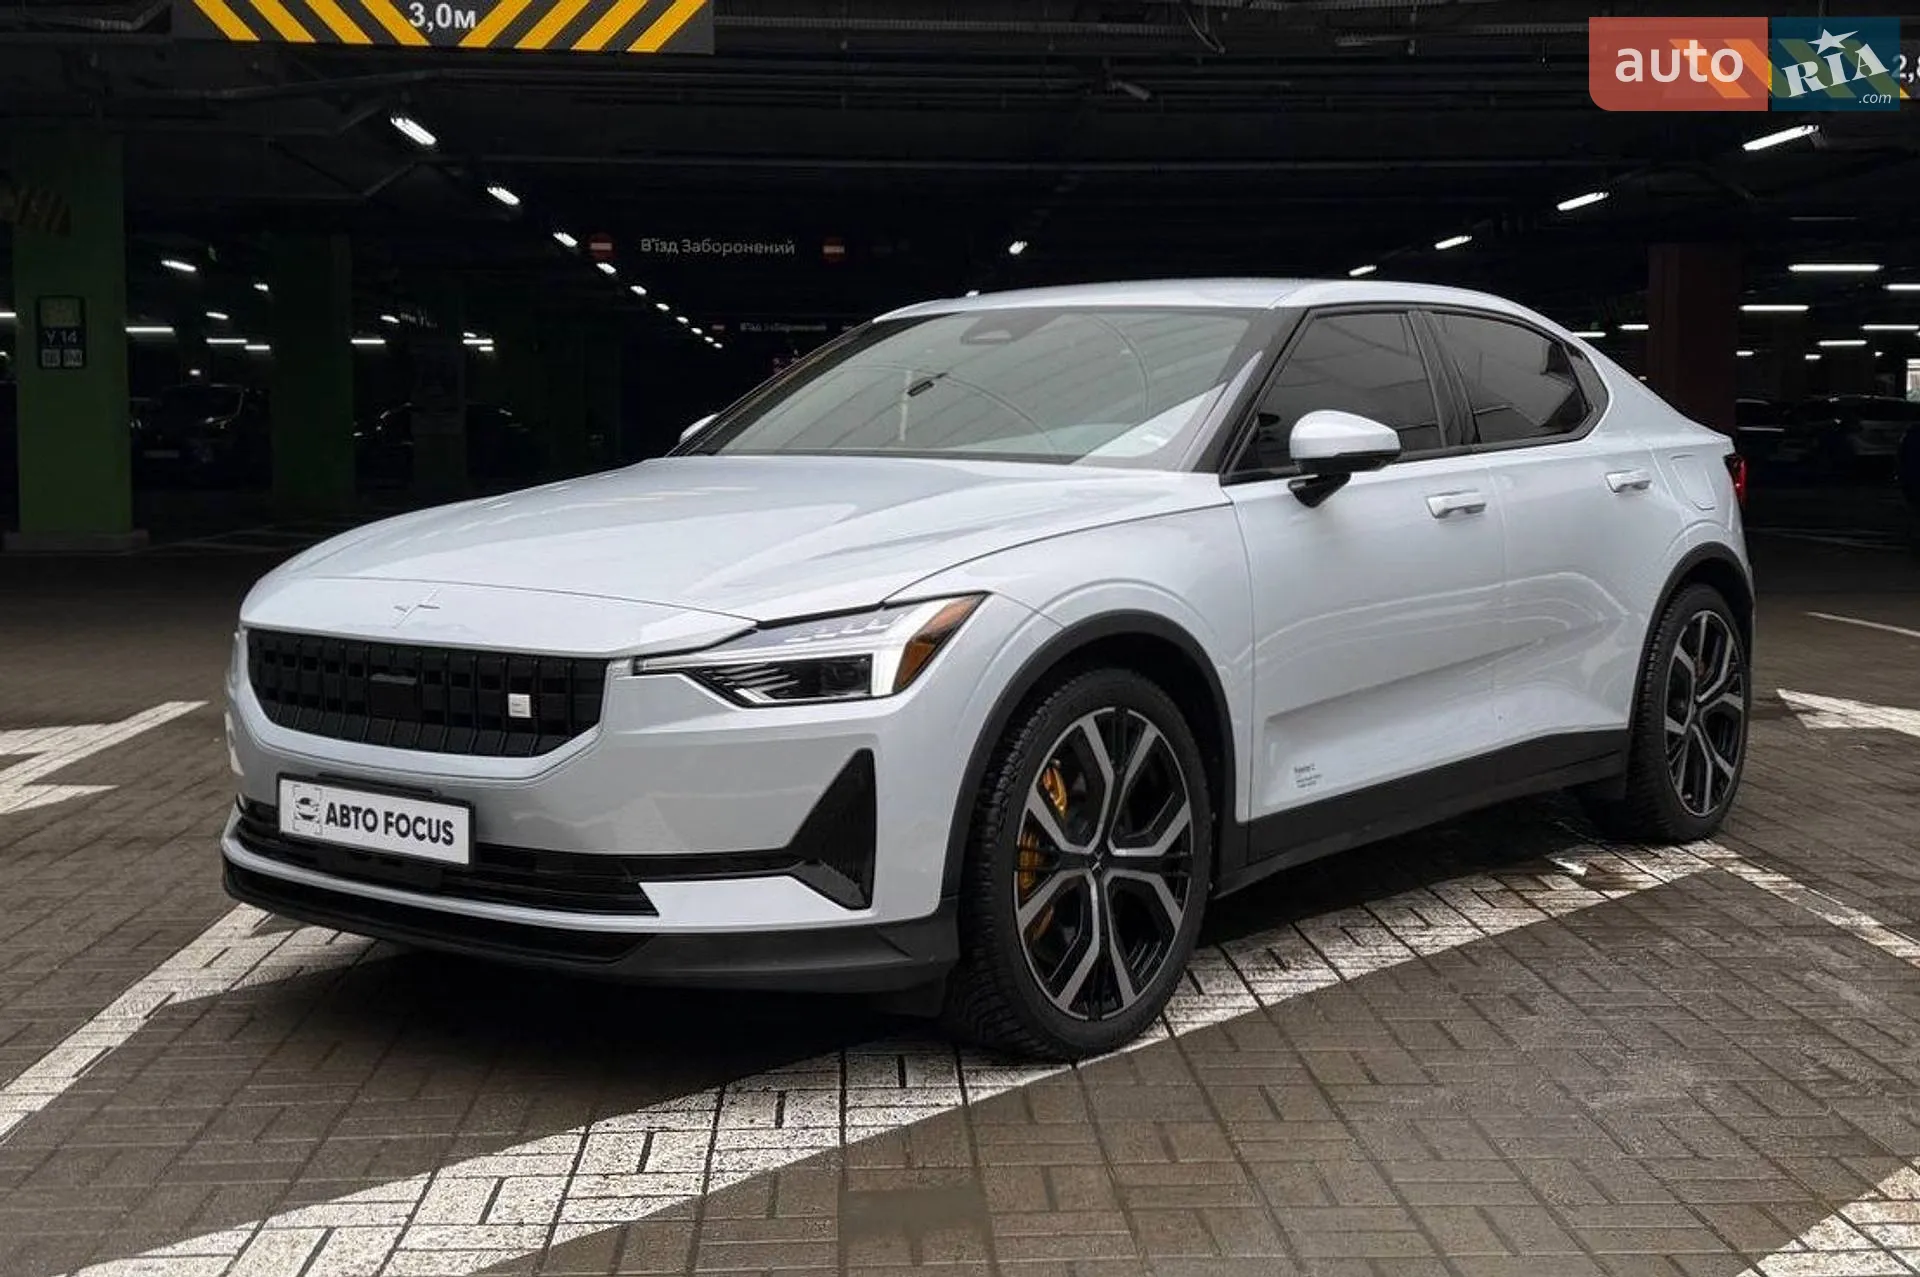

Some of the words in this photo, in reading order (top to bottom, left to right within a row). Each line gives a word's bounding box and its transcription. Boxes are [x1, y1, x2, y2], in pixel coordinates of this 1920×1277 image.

[408, 2, 476, 33] 3,0м
[681, 237, 797, 257] Заборонений
[384, 810, 454, 846] FOCUS
